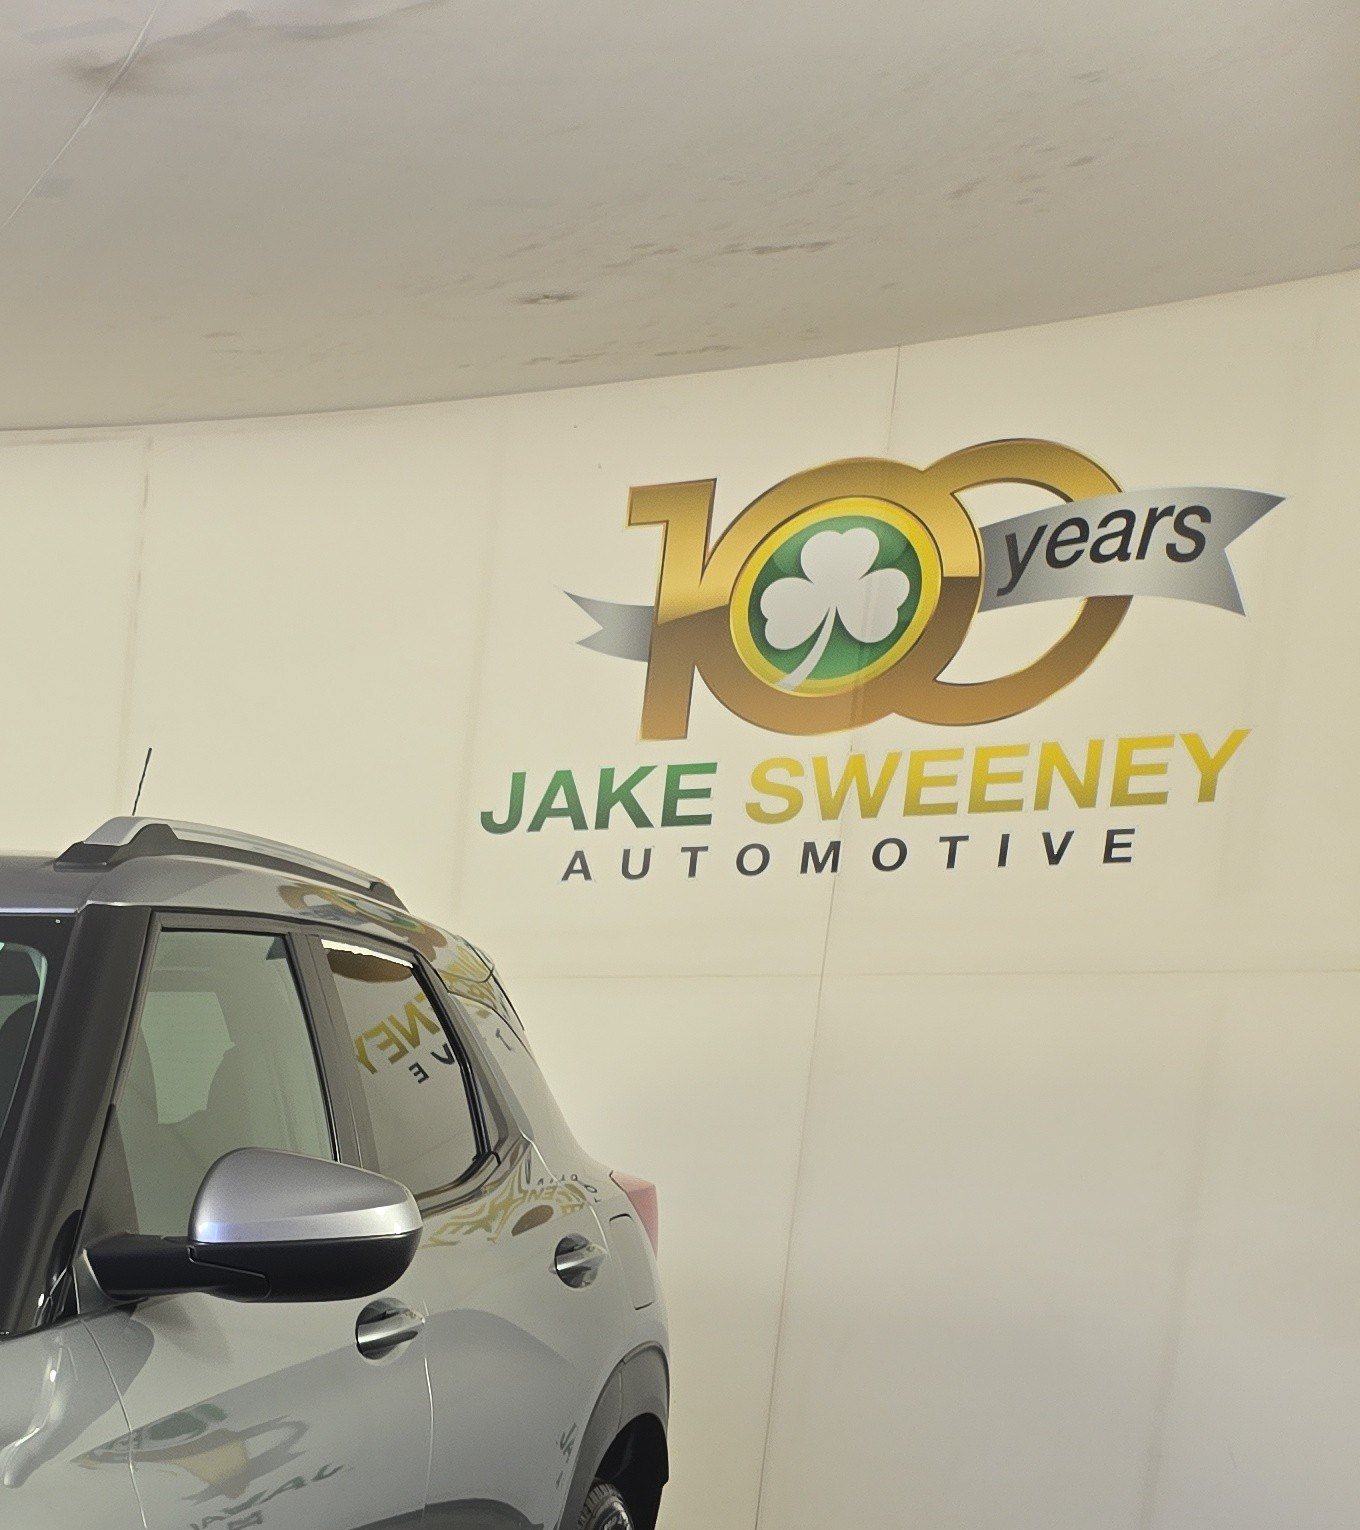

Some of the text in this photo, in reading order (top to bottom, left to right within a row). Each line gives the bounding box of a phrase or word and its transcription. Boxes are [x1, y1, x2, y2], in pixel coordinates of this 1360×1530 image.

[626, 437, 1137, 743] 100
[996, 503, 1212, 597] years
[479, 728, 1252, 834] JAKE SWEENEY
[561, 827, 1136, 883] AUTOMOTIVE
